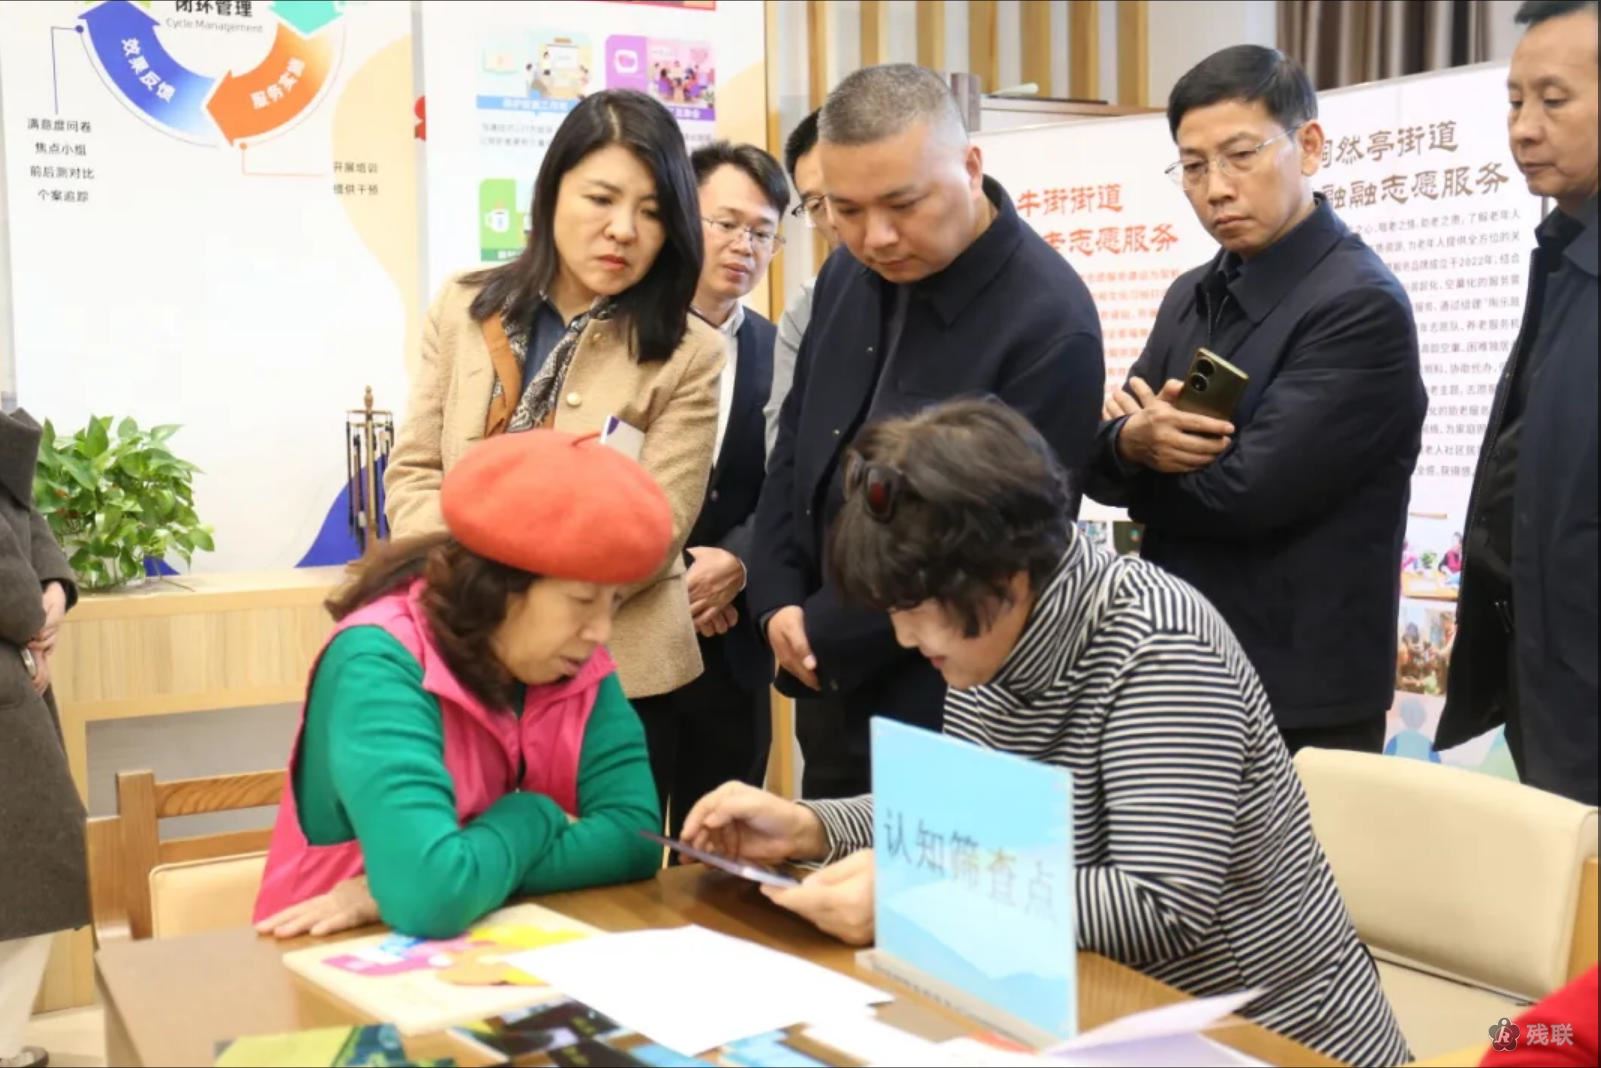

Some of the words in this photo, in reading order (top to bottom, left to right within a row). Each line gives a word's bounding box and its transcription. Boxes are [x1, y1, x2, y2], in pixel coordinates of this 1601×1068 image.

[175, 1, 252, 17] 闭环管理
[165, 17, 193, 28] Cycle
[195, 19, 263, 32] Management
[27, 118, 91, 133] 满意度问卷
[35, 142, 86, 156] 焦点小组
[30, 165, 95, 179] 前后测对比
[38, 189, 88, 202] 个案追踪
[1017, 184, 1123, 217] 牛街街道
[884, 808, 1057, 922] 认知筛查点
